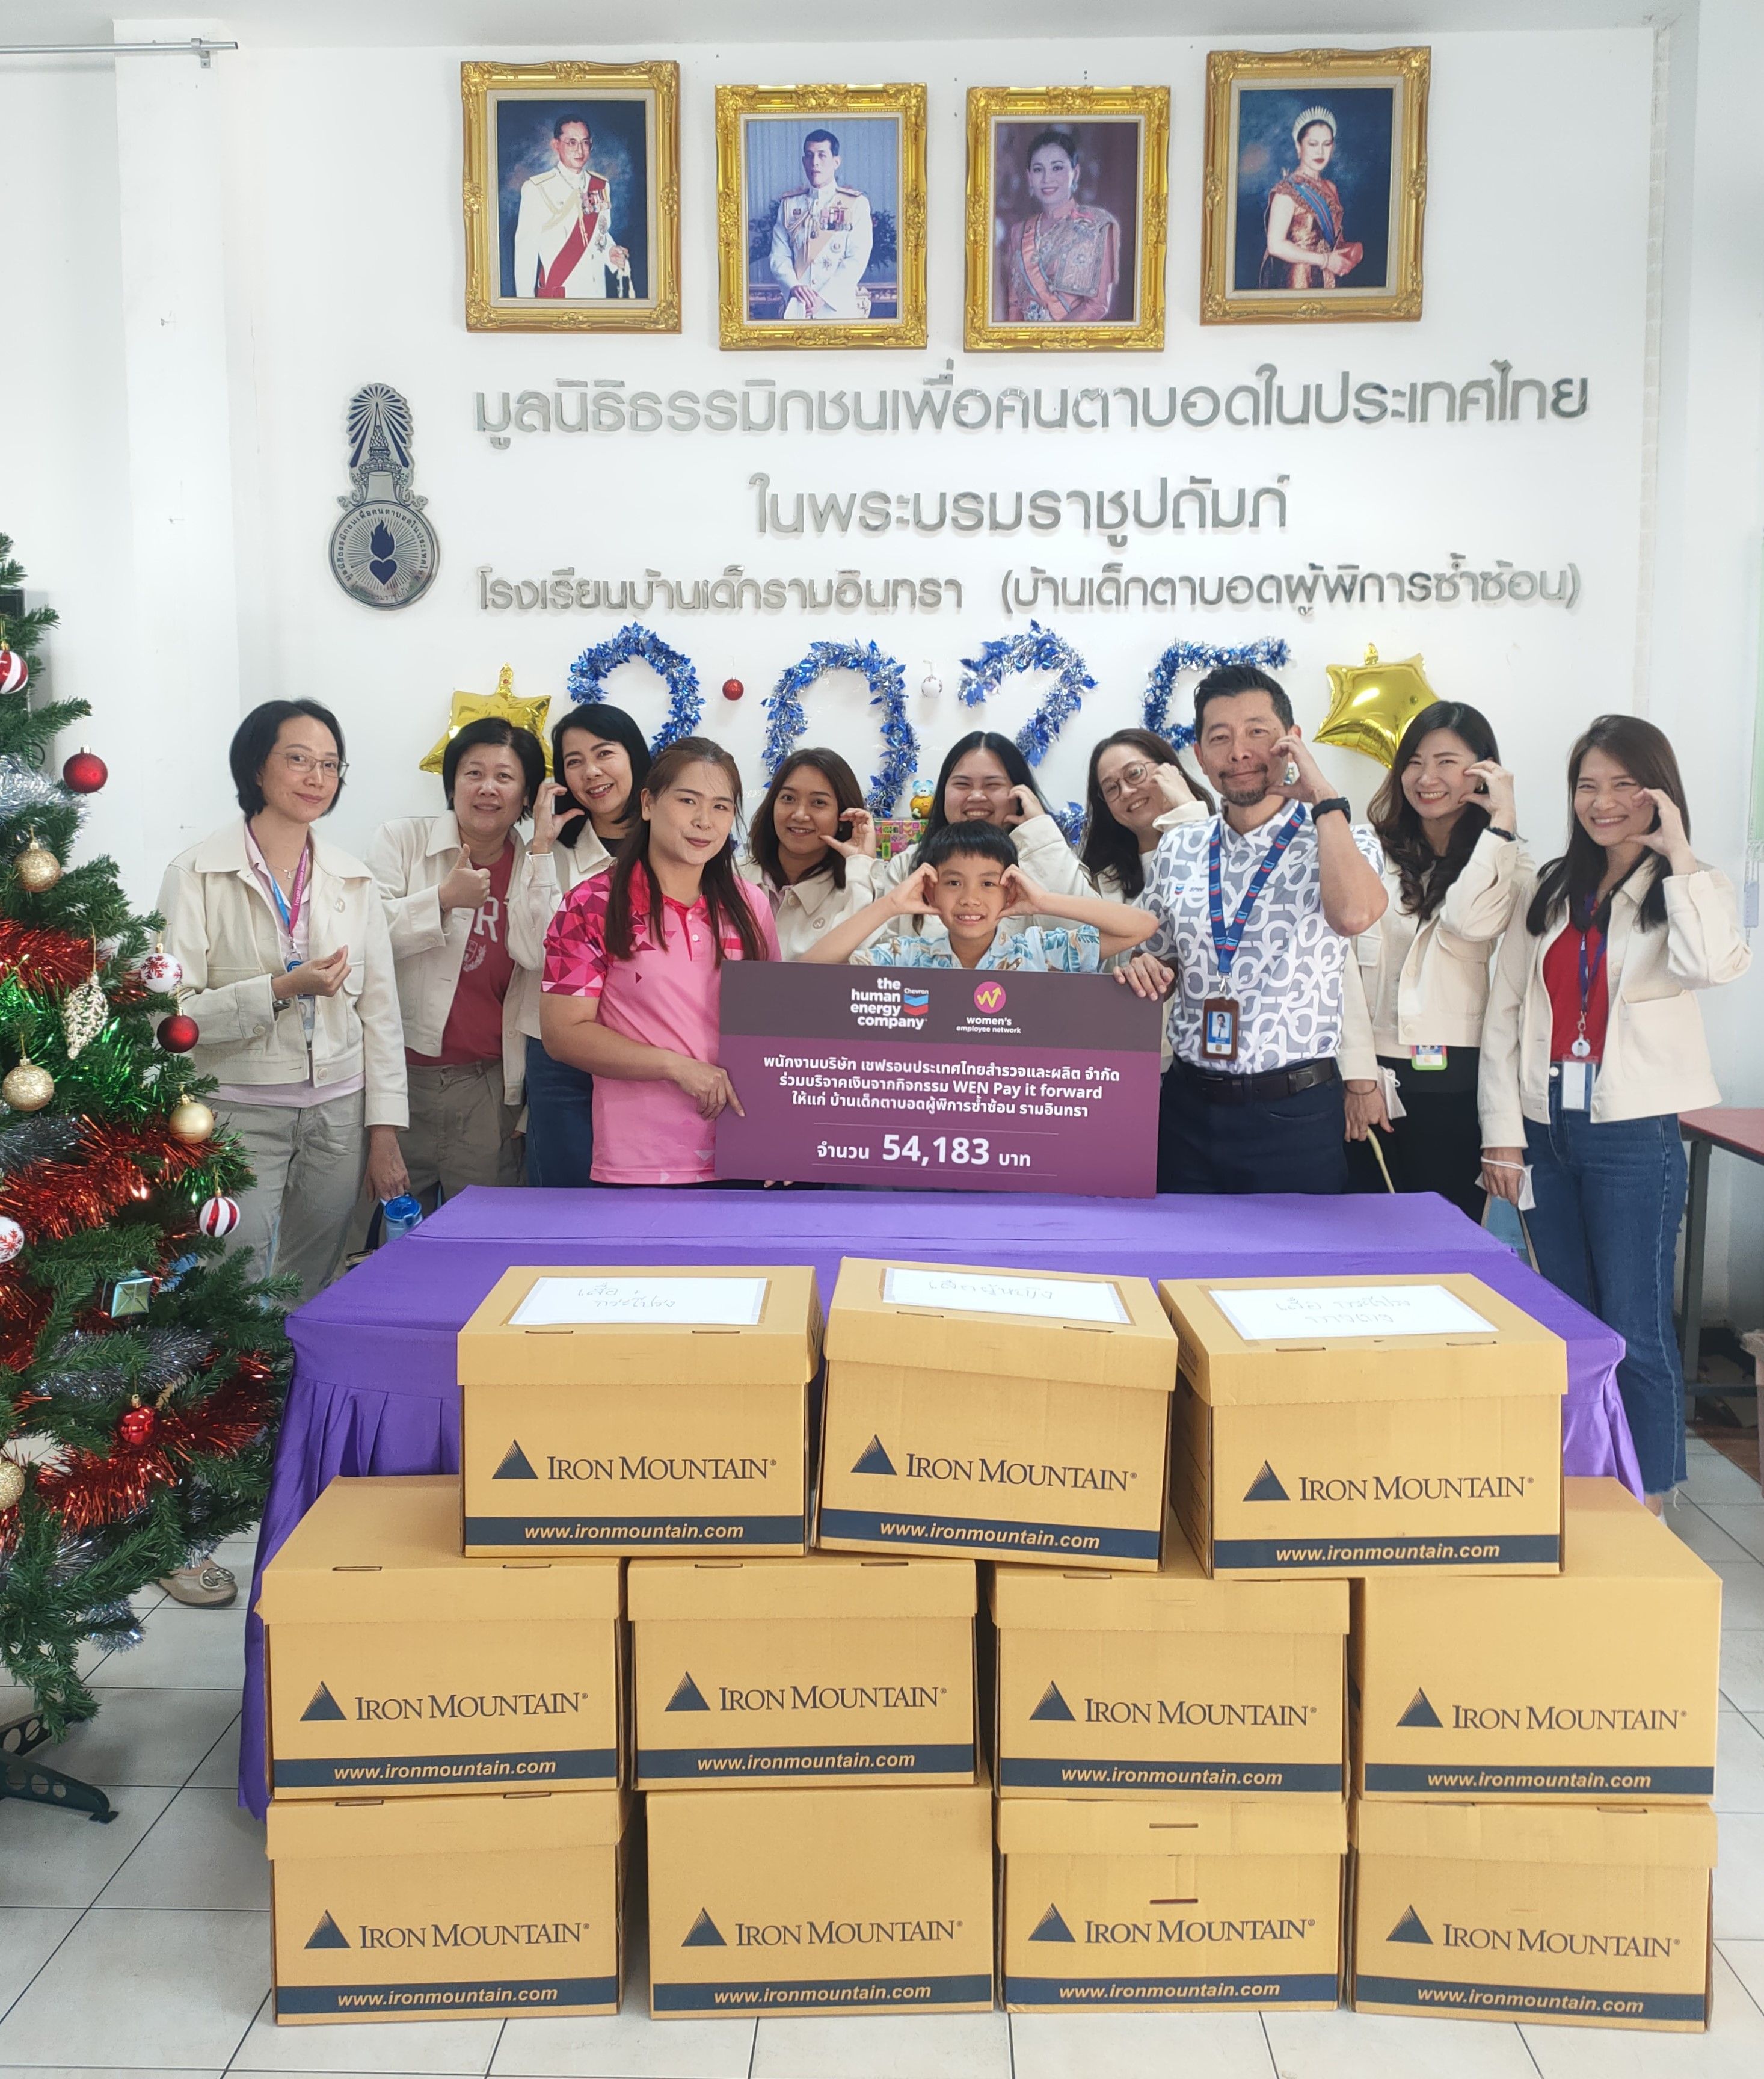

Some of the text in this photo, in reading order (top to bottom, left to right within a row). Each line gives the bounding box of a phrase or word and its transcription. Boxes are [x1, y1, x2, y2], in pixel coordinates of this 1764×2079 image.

[476, 358, 1589, 450] มูลนิธิธรรมิกชนเพื่อคนตาบอดในประเทศไทย
[749, 472, 1291, 548] ในพระบรมราชูปถัมภ์
[479, 552, 1581, 617] โรงเรียนบ้านเด็กรามอินทรา (บ้านเด็กตาบอดผู้พิการซ้ำซ้อน)
[877, 977, 901, 990] the
[851, 988, 901, 1002] human
[850, 1003, 901, 1017] energy
[966, 1016, 1012, 1026] women's
[956, 1025, 991, 1033] employee
[764, 1053, 1120, 1082] พนักงานบริษัท เชฟรอนประเทศไทยสำรวจและผลิต จำกัด
[779, 1071, 1103, 1100] ร่วมบริจาคเงินจากกิจกรรม WEN Pay it forward
[791, 1089, 1089, 1118] ให้แก่ บ้านเด็กตาบอดผู้พิการซ้ำซ้อน รามอินทรา
[817, 1133, 1031, 1167] จำนวน 54,183 บาท
[547, 1457, 613, 1480] IRON
[906, 1453, 973, 1480] IRON
[1299, 1477, 1367, 1500] IRON
[524, 1523, 744, 1539] www.ironmountain.com
[880, 1522, 1100, 1549] www.ironmountain.com
[1277, 1544, 1499, 1560] www.ironmountain.com
[355, 1697, 423, 1720] IRON
[719, 1688, 784, 1710] IRON
[1085, 1699, 1151, 1723] IRON
[1453, 1705, 1519, 1729] IRON
[334, 1760, 556, 1779] www.ironmountain.com
[698, 1753, 914, 1770] www.ironmountain.com
[1062, 1767, 1282, 1784] www.ironmountain.com
[1428, 1772, 1650, 1787] www.ironmountain.com
[359, 1926, 426, 1948] IRON
[736, 1924, 801, 1945] IRON
[1086, 1921, 1151, 1943] IRON
[1443, 1924, 1510, 1950] IRON
[338, 1988, 558, 2007] www.ironmountain.com
[715, 1985, 931, 2003] www.ironmountain.com
[1060, 1983, 1280, 1998] www.ironmountain.com
[1418, 1989, 1644, 2013] www.ironmountain.com
